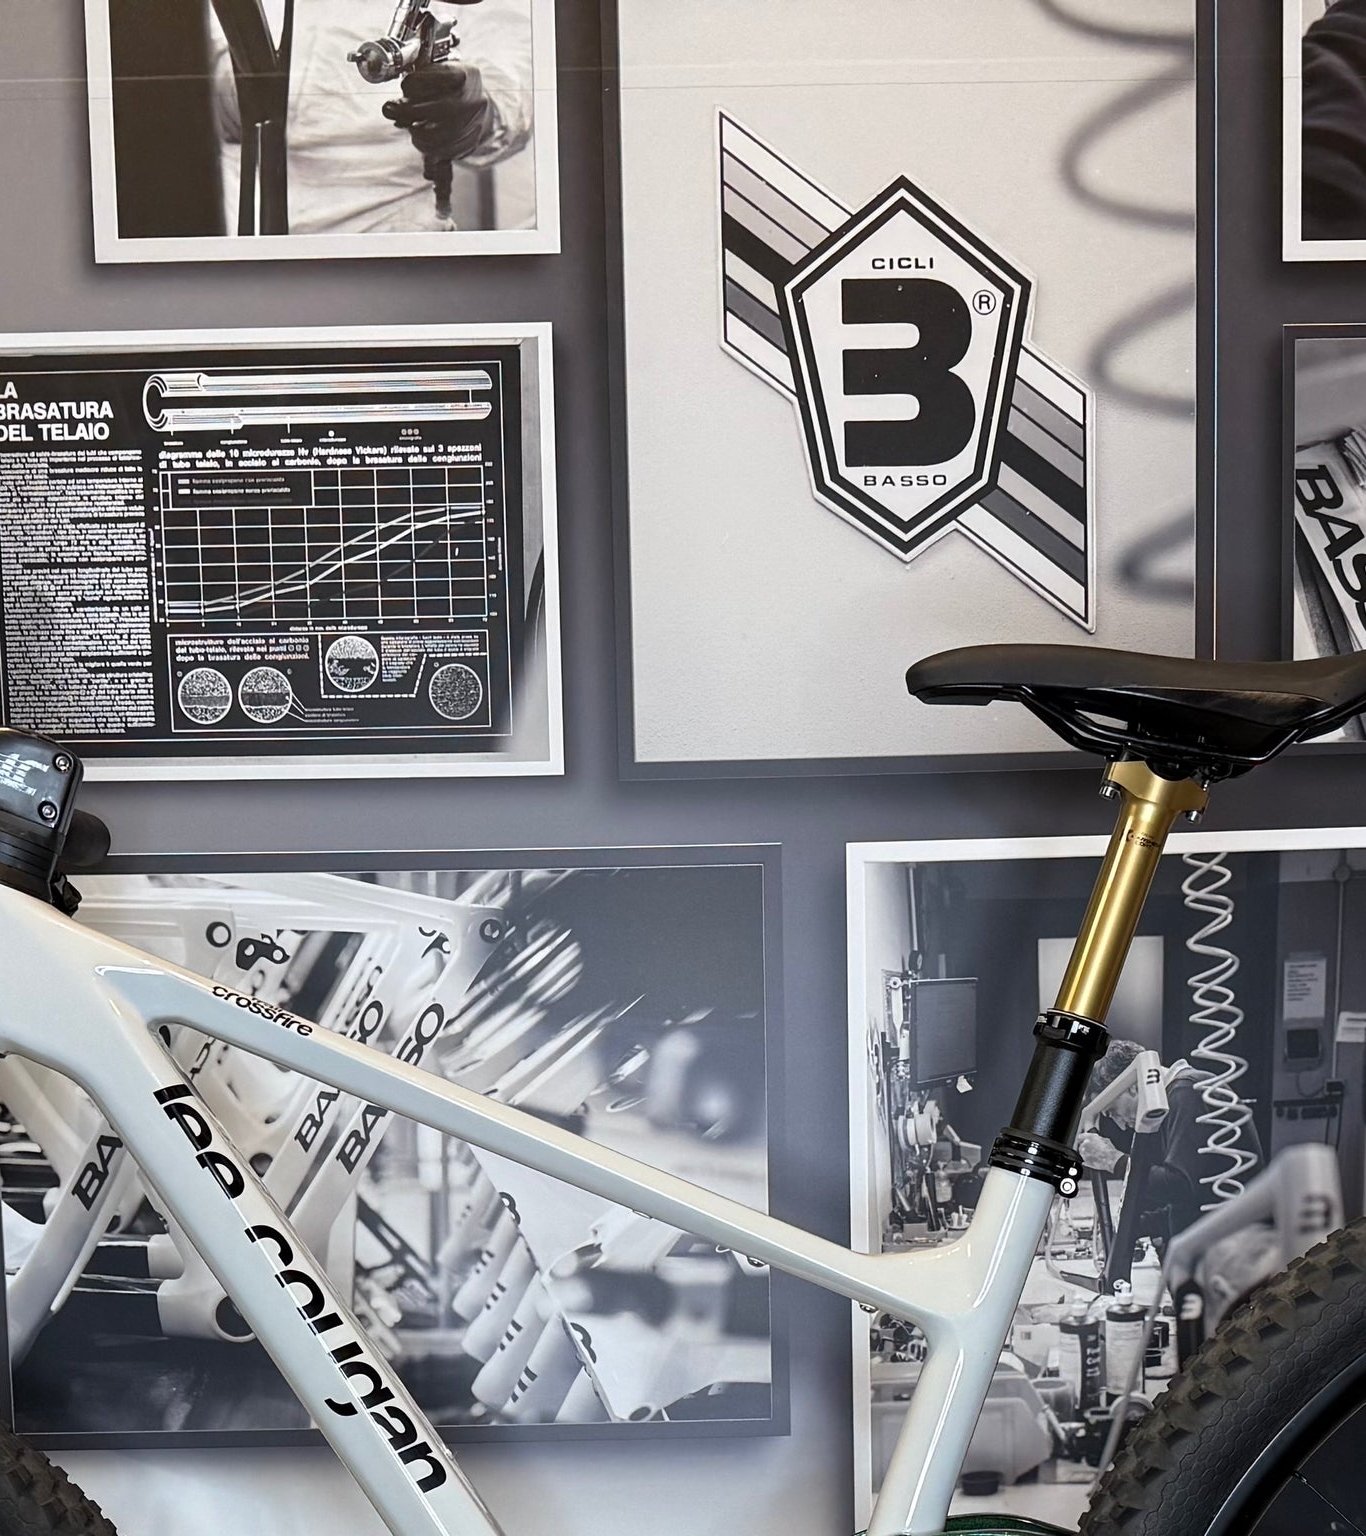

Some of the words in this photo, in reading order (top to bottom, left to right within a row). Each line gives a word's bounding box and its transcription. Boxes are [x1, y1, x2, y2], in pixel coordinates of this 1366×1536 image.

[871, 257, 934, 270] CICLI
[38, 422, 110, 441] TELAIO
[863, 474, 947, 487] BASSO
[212, 986, 313, 1036] crossfire
